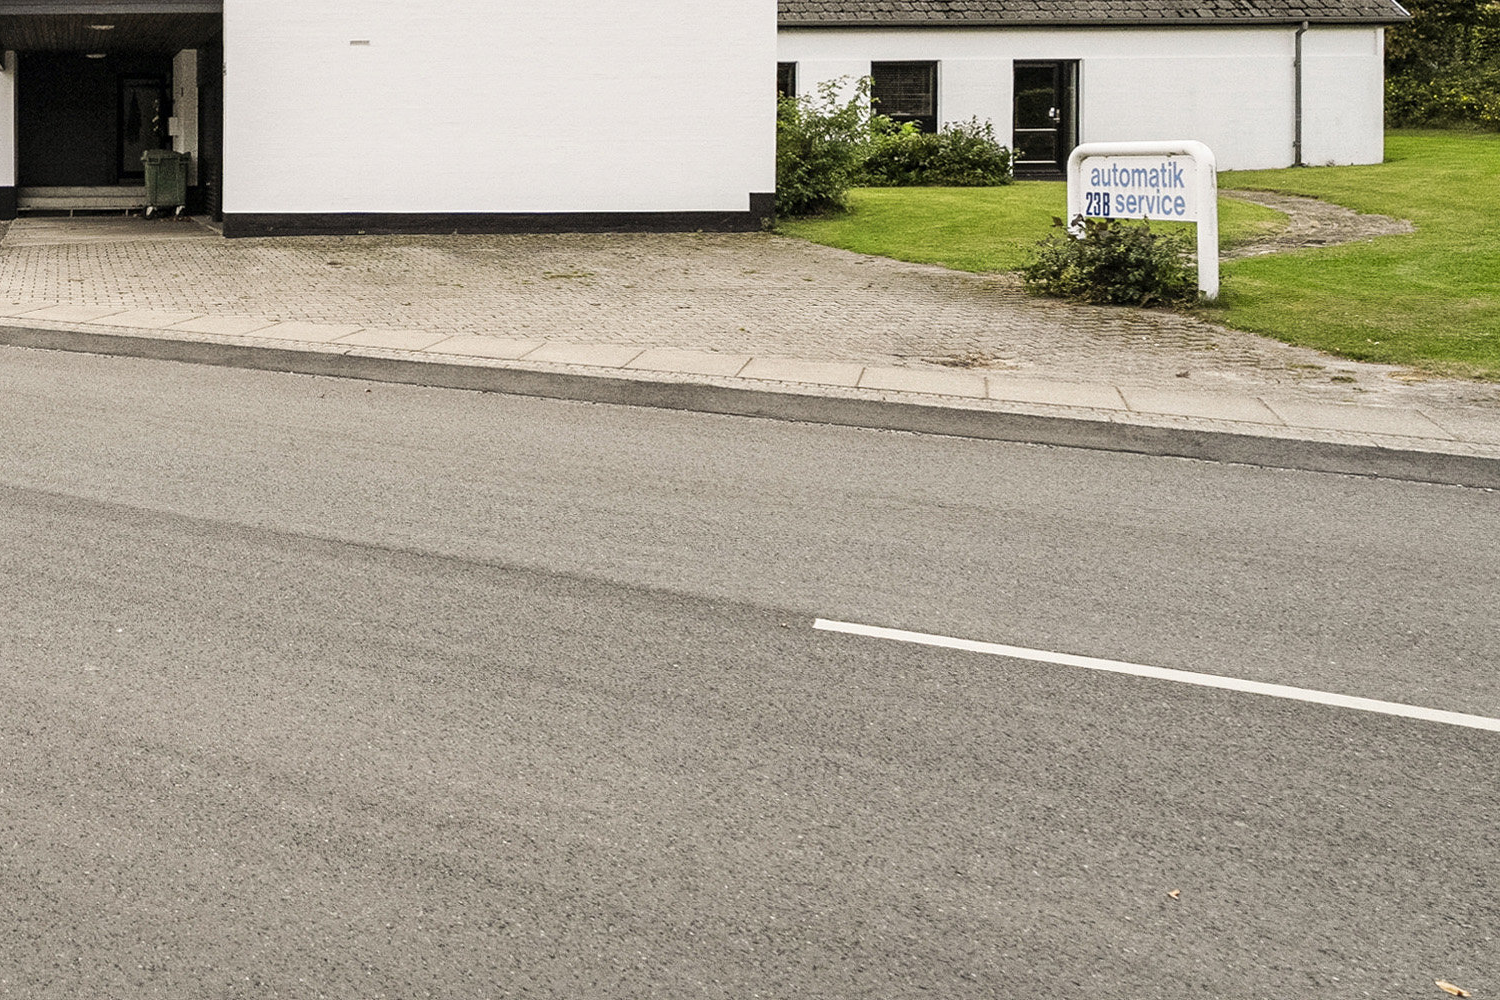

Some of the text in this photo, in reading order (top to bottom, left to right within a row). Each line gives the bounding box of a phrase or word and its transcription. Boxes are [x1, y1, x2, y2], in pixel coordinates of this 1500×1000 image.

[1090, 161, 1185, 188] automatik
[1086, 192, 1110, 216] 23B
[1115, 189, 1186, 216] service
